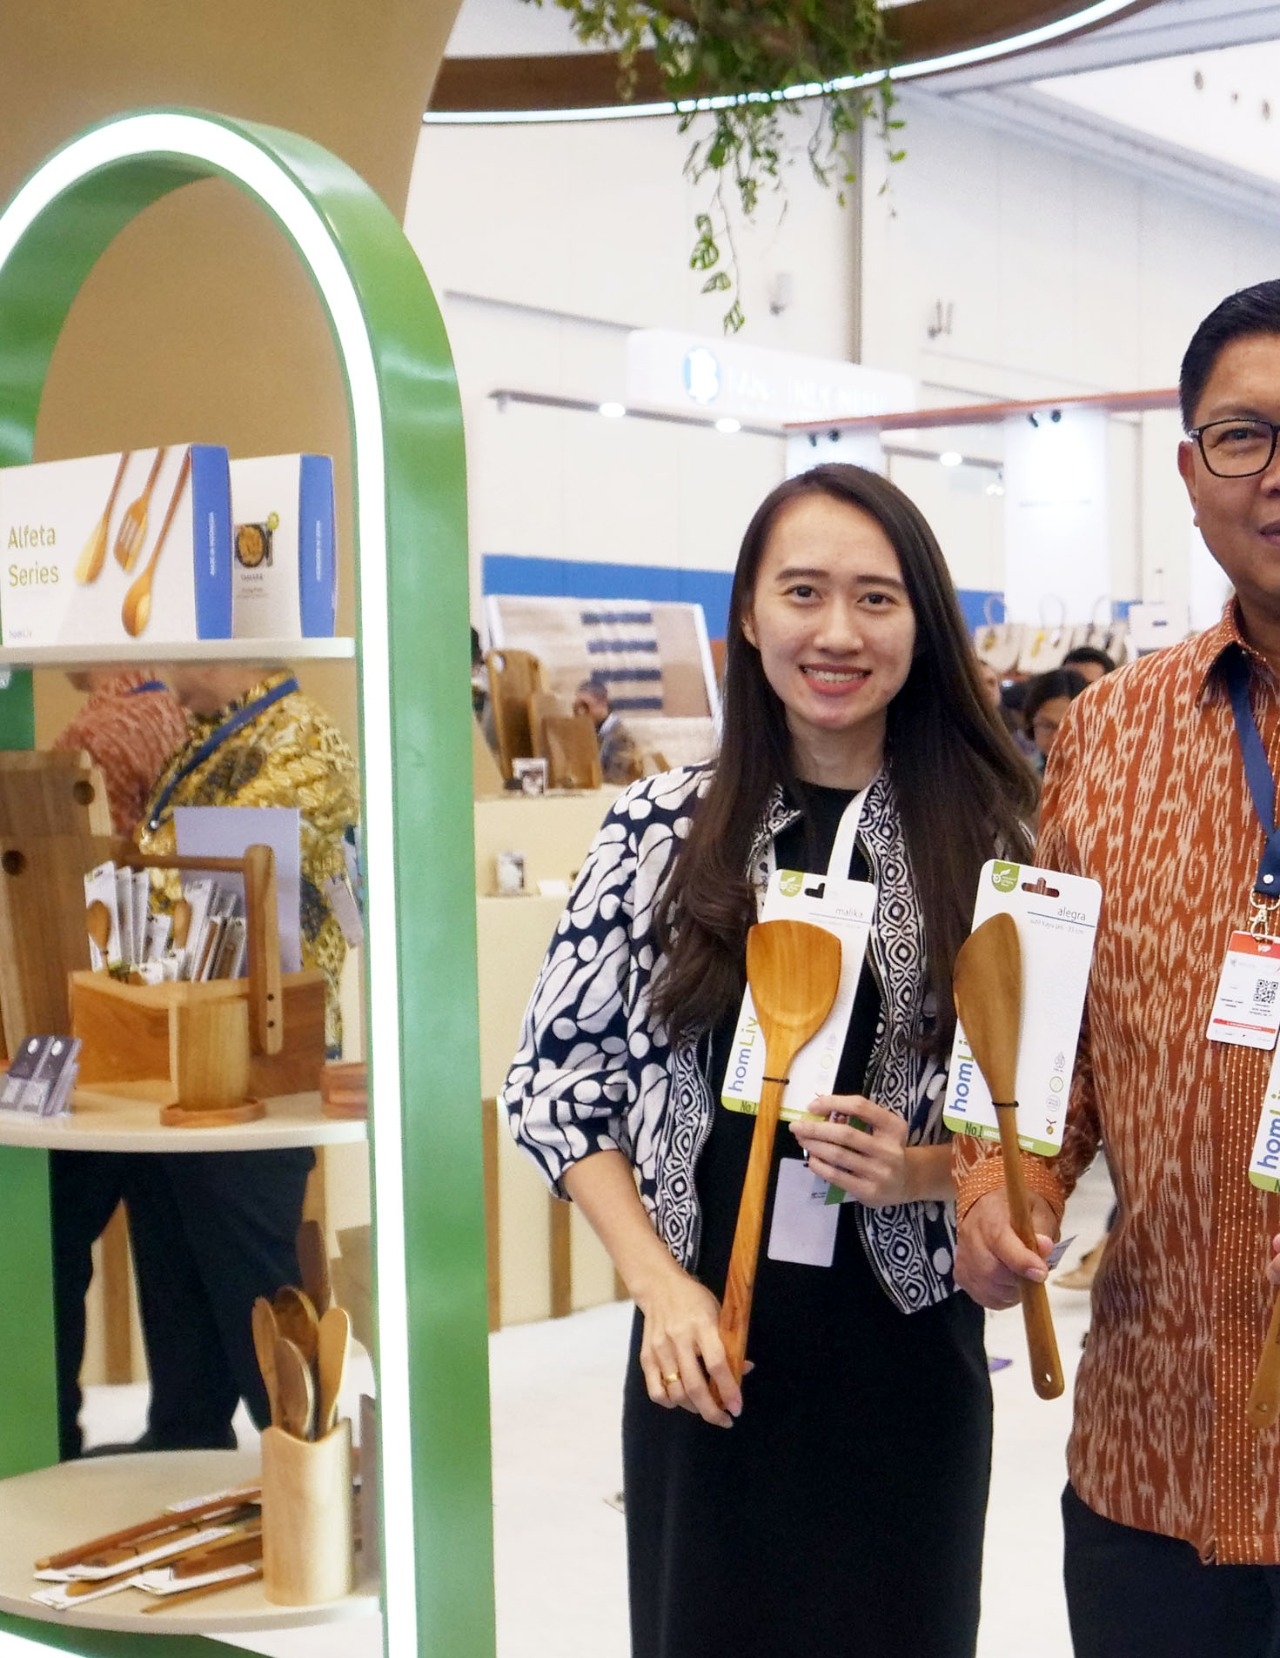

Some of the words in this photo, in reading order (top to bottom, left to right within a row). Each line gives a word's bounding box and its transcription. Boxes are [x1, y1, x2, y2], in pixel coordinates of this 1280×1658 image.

[8, 524, 56, 549] Alfeta
[8, 560, 60, 587] Series
[1057, 907, 1086, 922] alegra
[728, 1016, 758, 1092] homLiv
